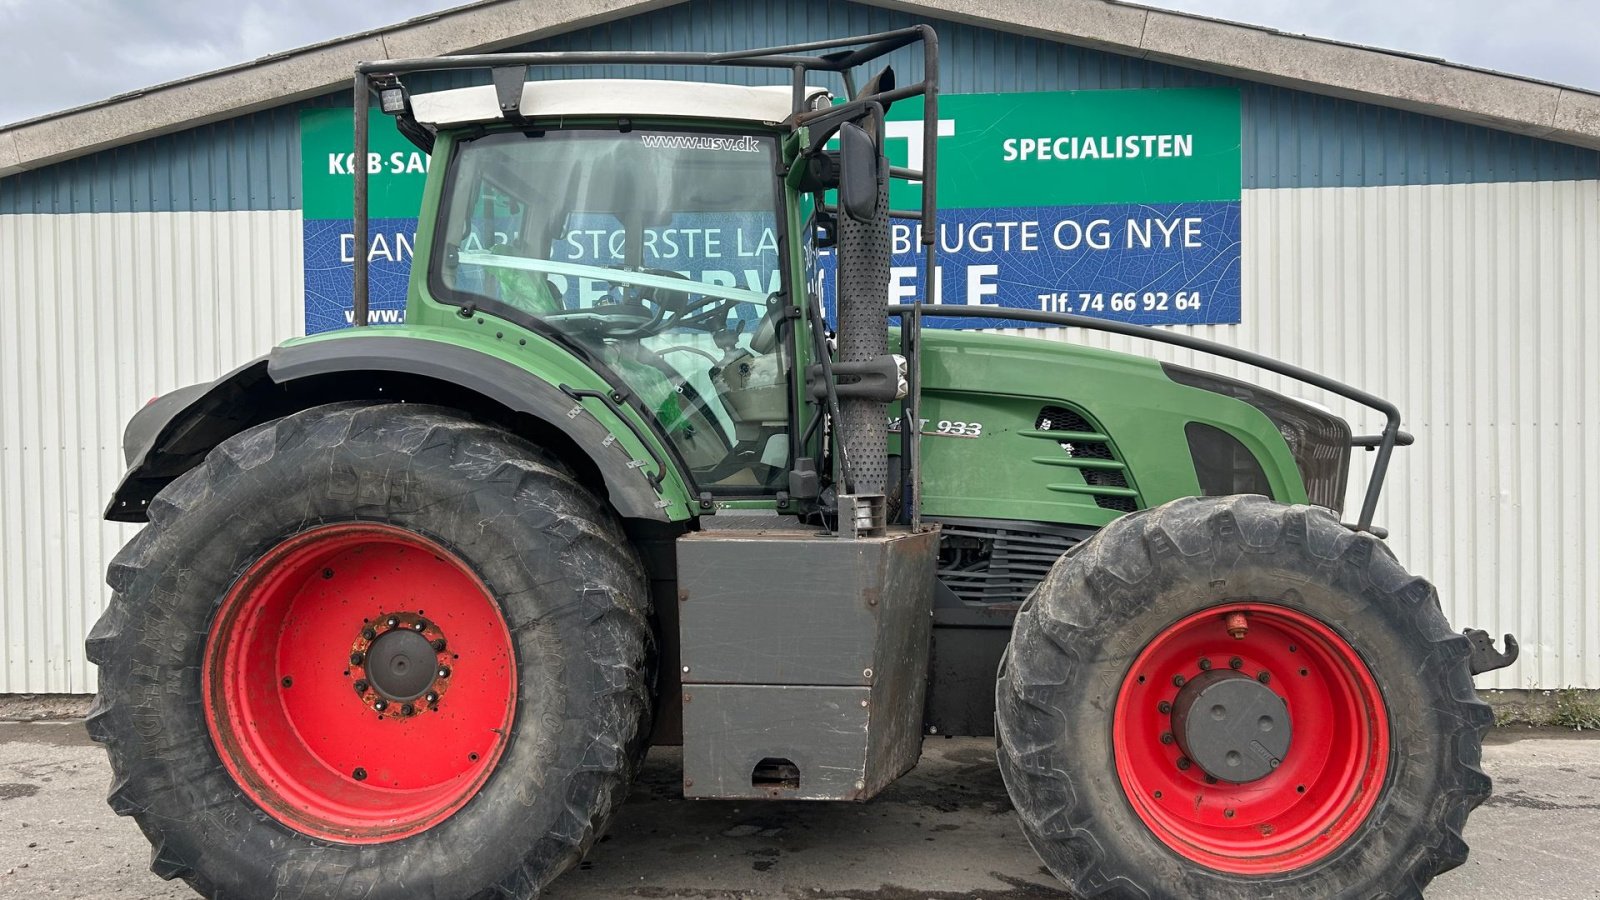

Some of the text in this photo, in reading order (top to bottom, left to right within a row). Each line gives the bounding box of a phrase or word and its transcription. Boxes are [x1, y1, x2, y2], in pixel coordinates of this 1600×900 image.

[641, 135, 760, 153] www.usv.dk
[1002, 134, 1193, 161] SPECIALISTEN
[1053, 218, 1111, 251] OG
[1127, 217, 1202, 249] NYE
[1038, 291, 1201, 312] Tlf. 74 66 92 64
[936, 420, 983, 436] 933
